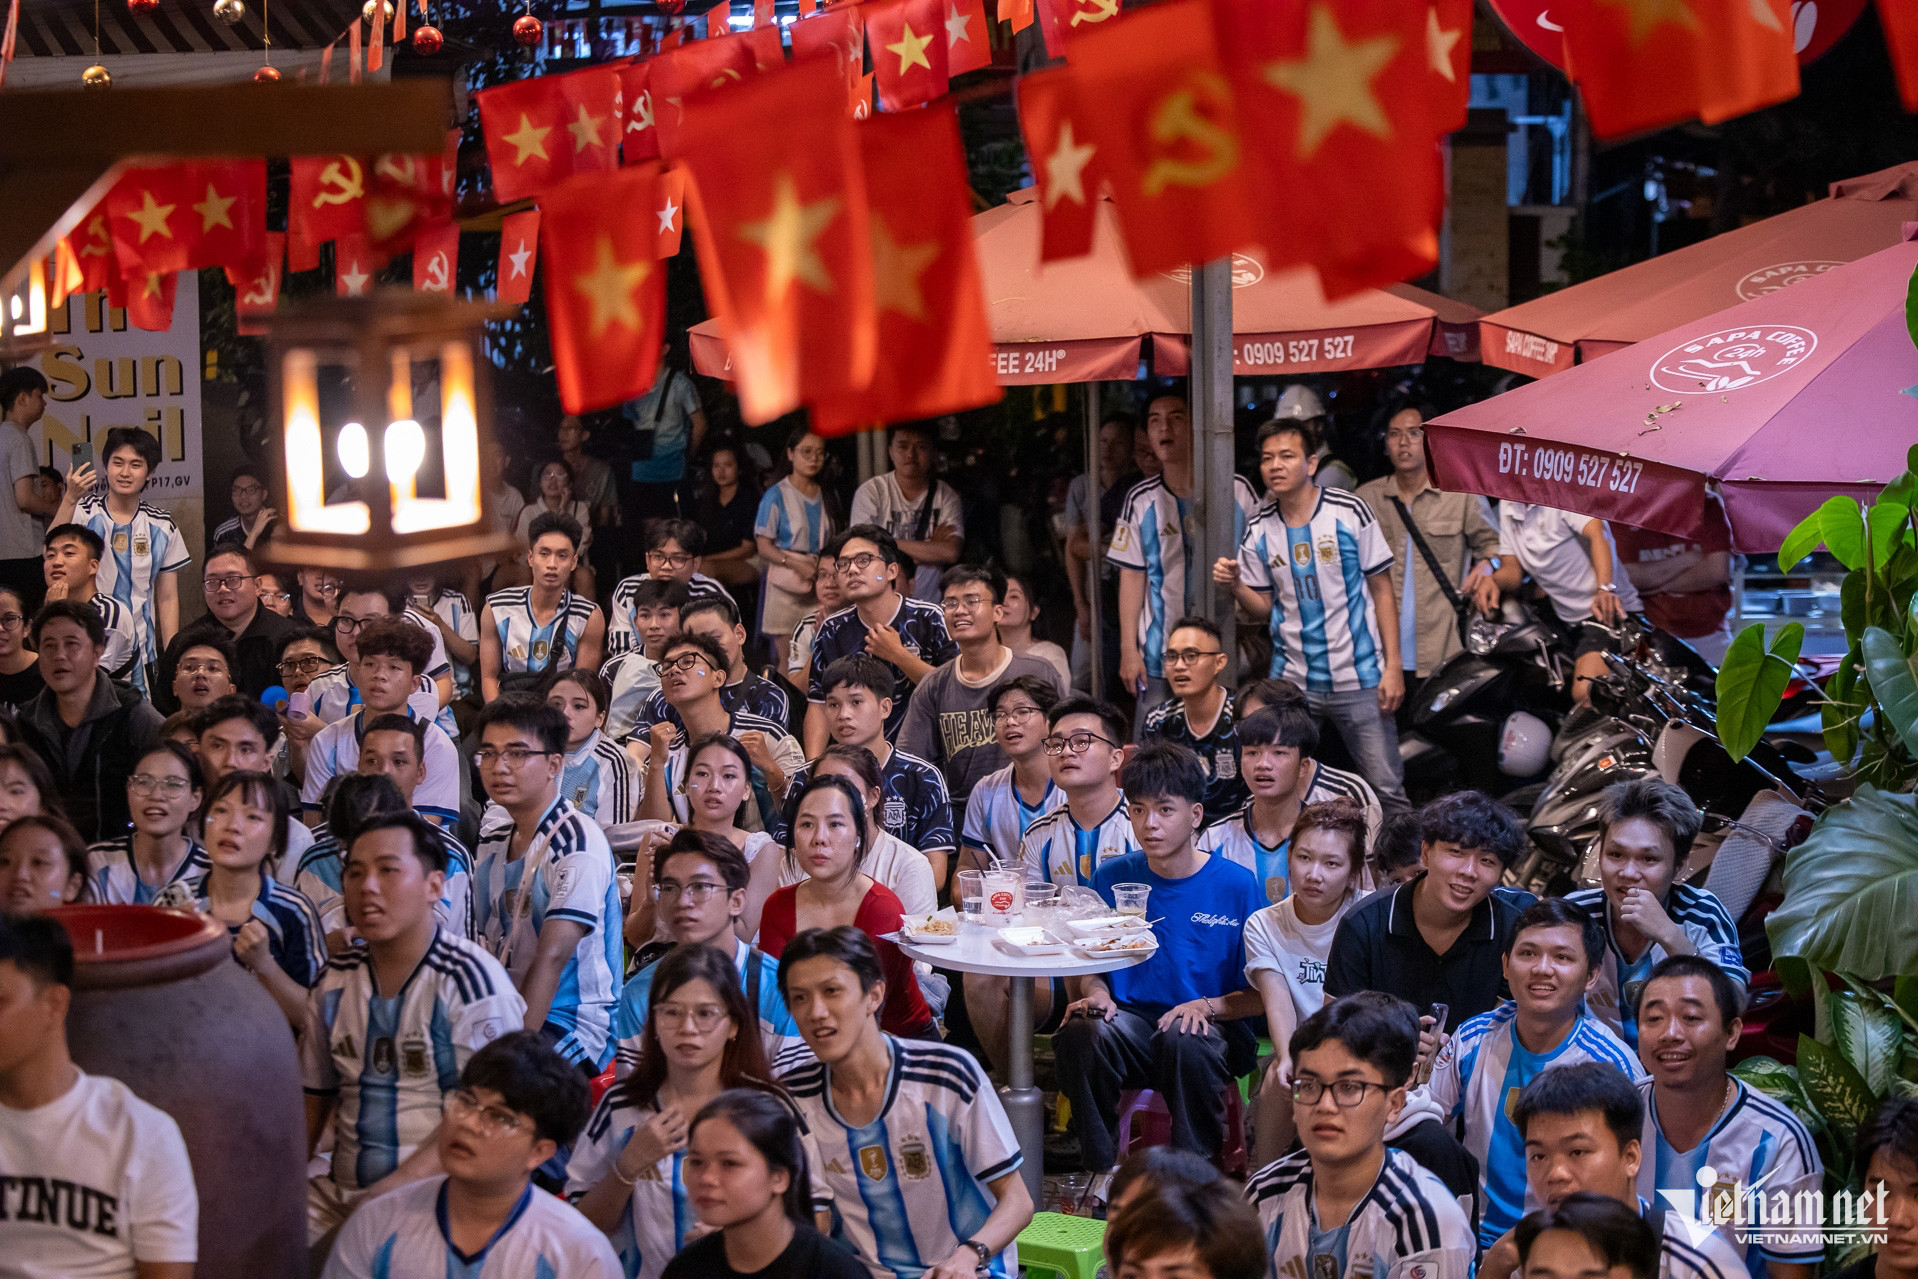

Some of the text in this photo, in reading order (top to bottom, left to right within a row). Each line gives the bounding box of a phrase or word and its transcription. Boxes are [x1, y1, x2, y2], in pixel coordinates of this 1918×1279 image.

[1243, 341, 1285, 366] 0909
[1288, 339, 1320, 363] 527
[1323, 335, 1355, 360] 527
[1684, 330, 1806, 366] SAPA COFFEE
[1723, 347, 1767, 359] 24h
[41, 345, 183, 402] Sun
[1499, 442, 1643, 494] ĐT: 0909 527 527
[1295, 575, 1319, 600] 10
[940, 708, 994, 762] HEAV
